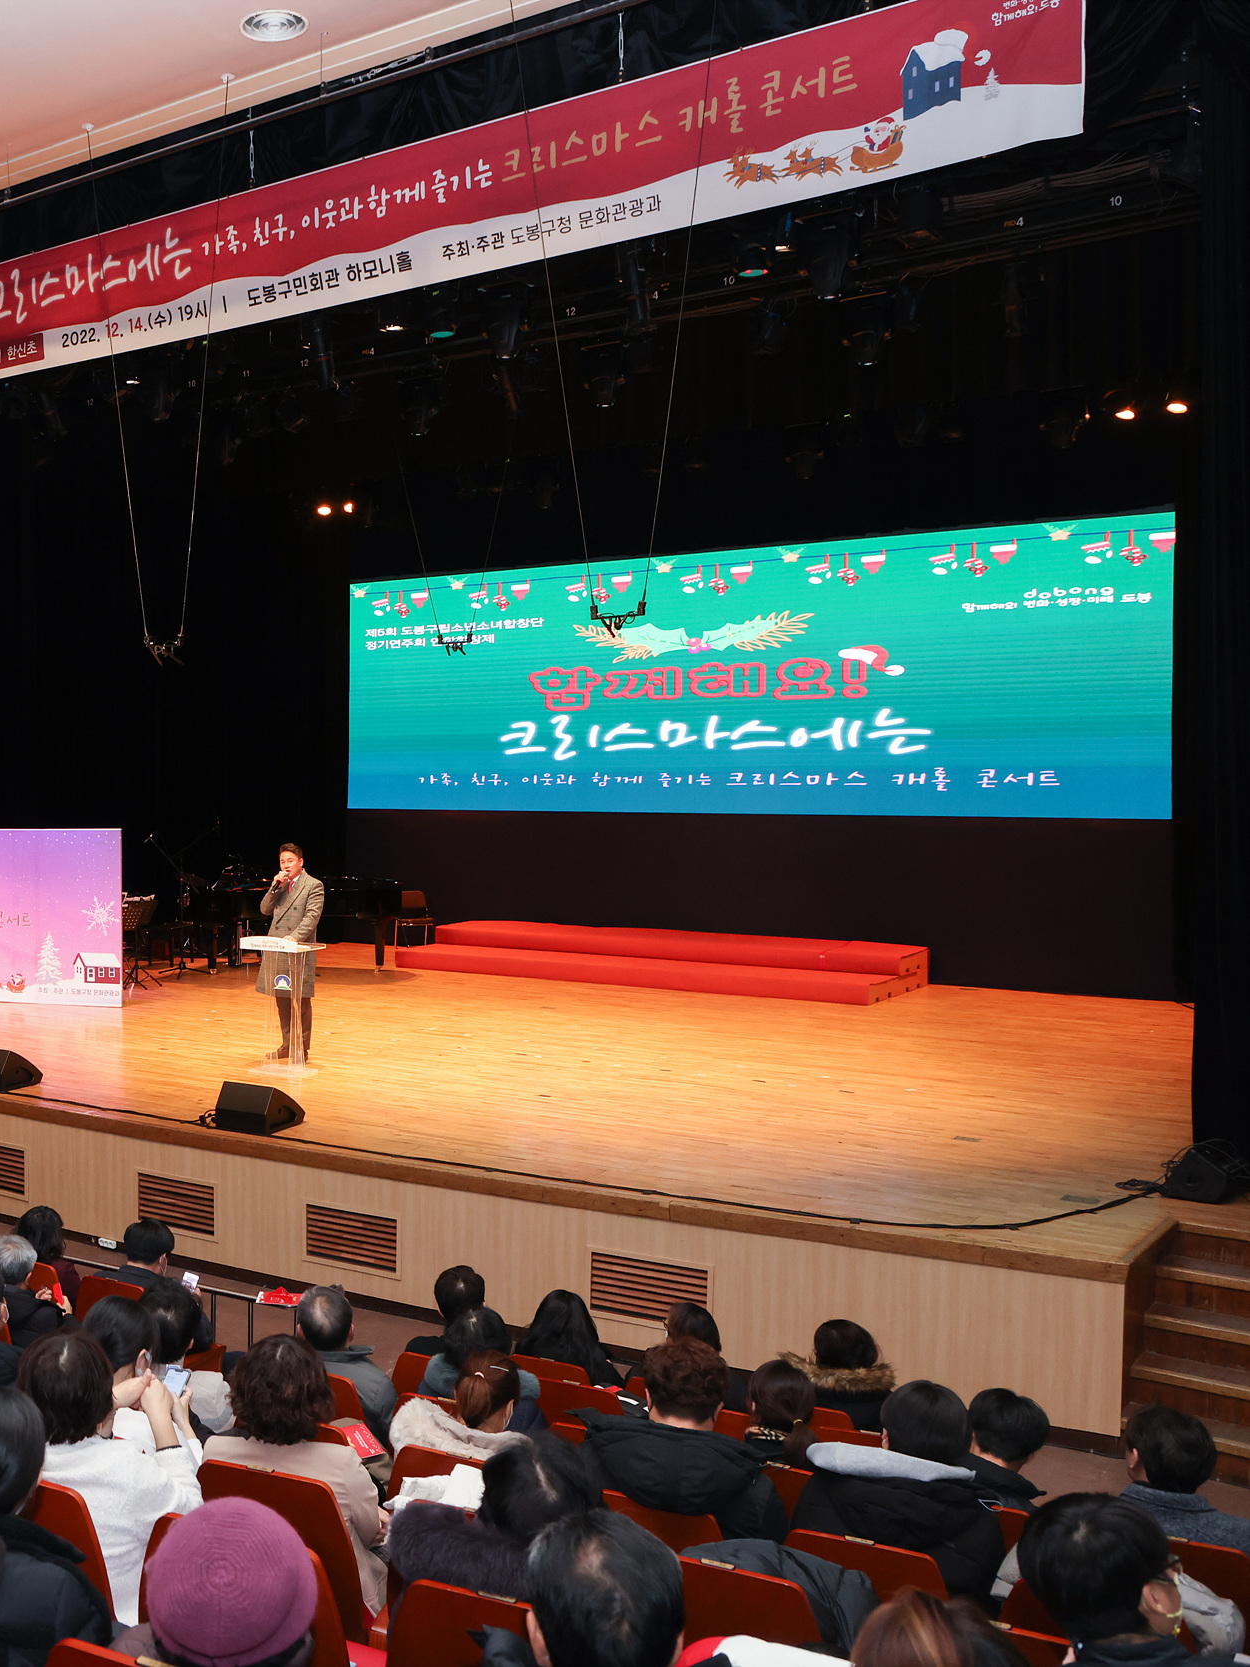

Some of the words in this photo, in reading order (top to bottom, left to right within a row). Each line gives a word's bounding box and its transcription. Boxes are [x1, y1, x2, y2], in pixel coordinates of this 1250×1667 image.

[991, 4, 1038, 27] 함께해요!
[201, 225, 247, 256] 가족,
[253, 213, 295, 247] 친구,
[301, 196, 364, 230] 이웃과
[366, 180, 426, 218] 함께
[431, 158, 493, 204] 즐기는
[501, 109, 662, 183] 크리스마스
[678, 76, 747, 133] 캐롤
[759, 55, 858, 117] 콘서트
[1110, 195, 1123, 207] 10
[61, 327, 101, 348] 2022.
[105, 322, 124, 339] 12.
[177, 299, 208, 322] 19시
[247, 268, 340, 307] 도봉구민회관
[345, 250, 413, 282] 하모니홀
[510, 215, 572, 246] 도봉구청
[578, 194, 662, 230] 문화관광과
[722, 275, 736, 286] 10
[565, 306, 577, 317] 12
[7, 341, 38, 361] 한신초
[300, 359, 309, 368] 12
[242, 369, 250, 378] 11
[187, 379, 197, 388] 10
[1023, 586, 1114, 599] dobong
[1120, 592, 1153, 604] 도봉
[364, 627, 397, 638] 제5회
[400, 617, 545, 636] 도봉구립소년소녀합창단
[364, 638, 426, 651] 정기연주회
[528, 657, 869, 713] 함께해요!
[500, 708, 932, 760] 크리스마스에는
[418, 772, 459, 787] 가족,
[470, 772, 509, 787] 친구,
[521, 772, 578, 786] 이웃과
[591, 772, 643, 787] 함께
[657, 772, 712, 788] 즐기는
[726, 771, 868, 786] 크리스마스
[891, 767, 951, 791] 캐롤
[976, 769, 1061, 788] 콘서트
